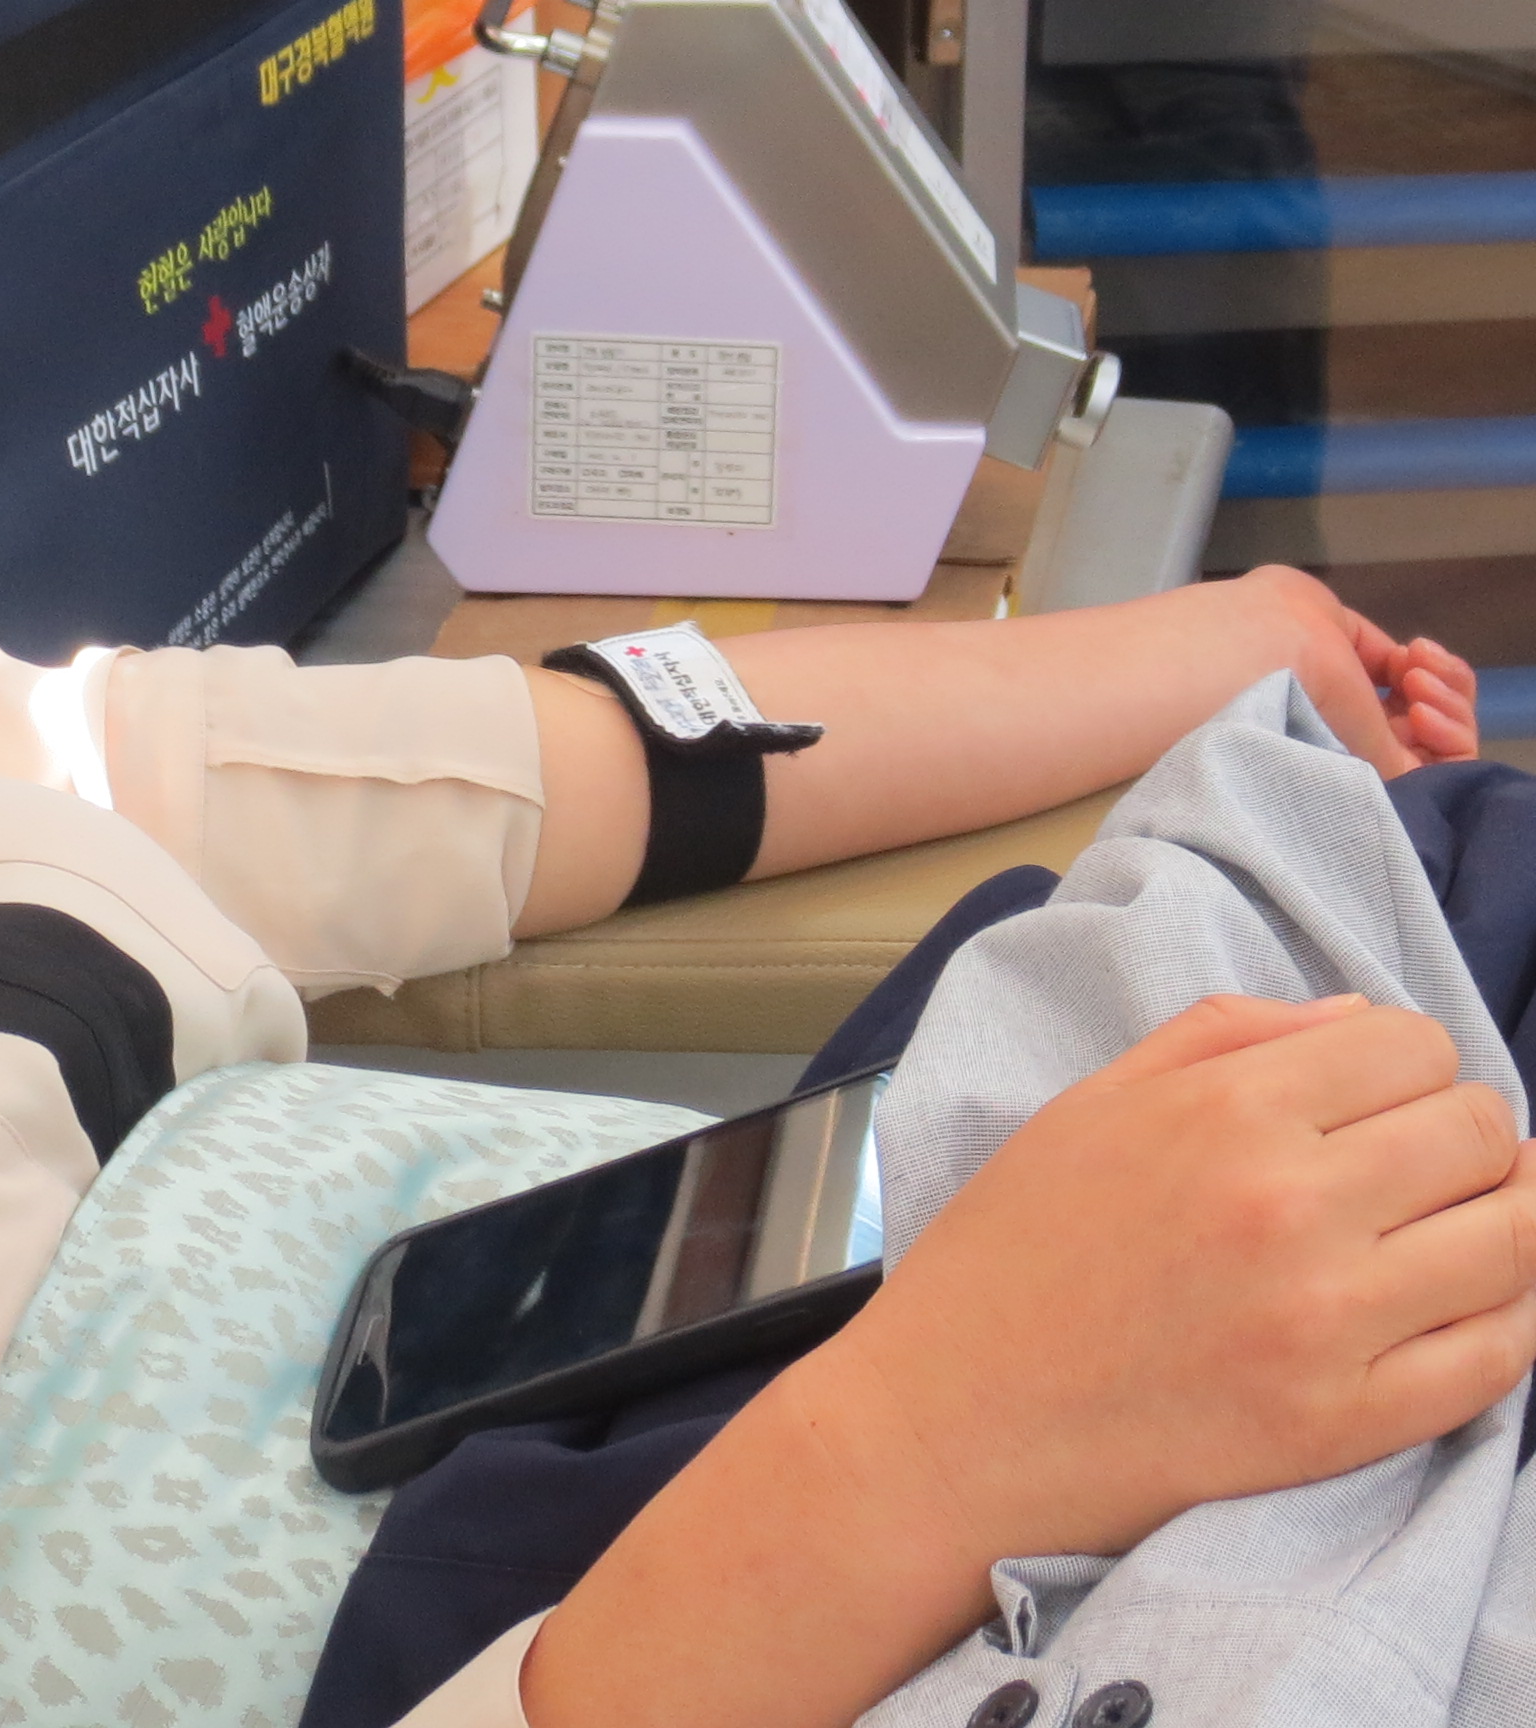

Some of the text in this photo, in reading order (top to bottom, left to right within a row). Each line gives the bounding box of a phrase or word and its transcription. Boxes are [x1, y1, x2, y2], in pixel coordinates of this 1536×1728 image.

[138, 186, 272, 314] 헌혈은 사랑입니다
[67, 240, 331, 476] 대한적십자사 혈액운송상자
